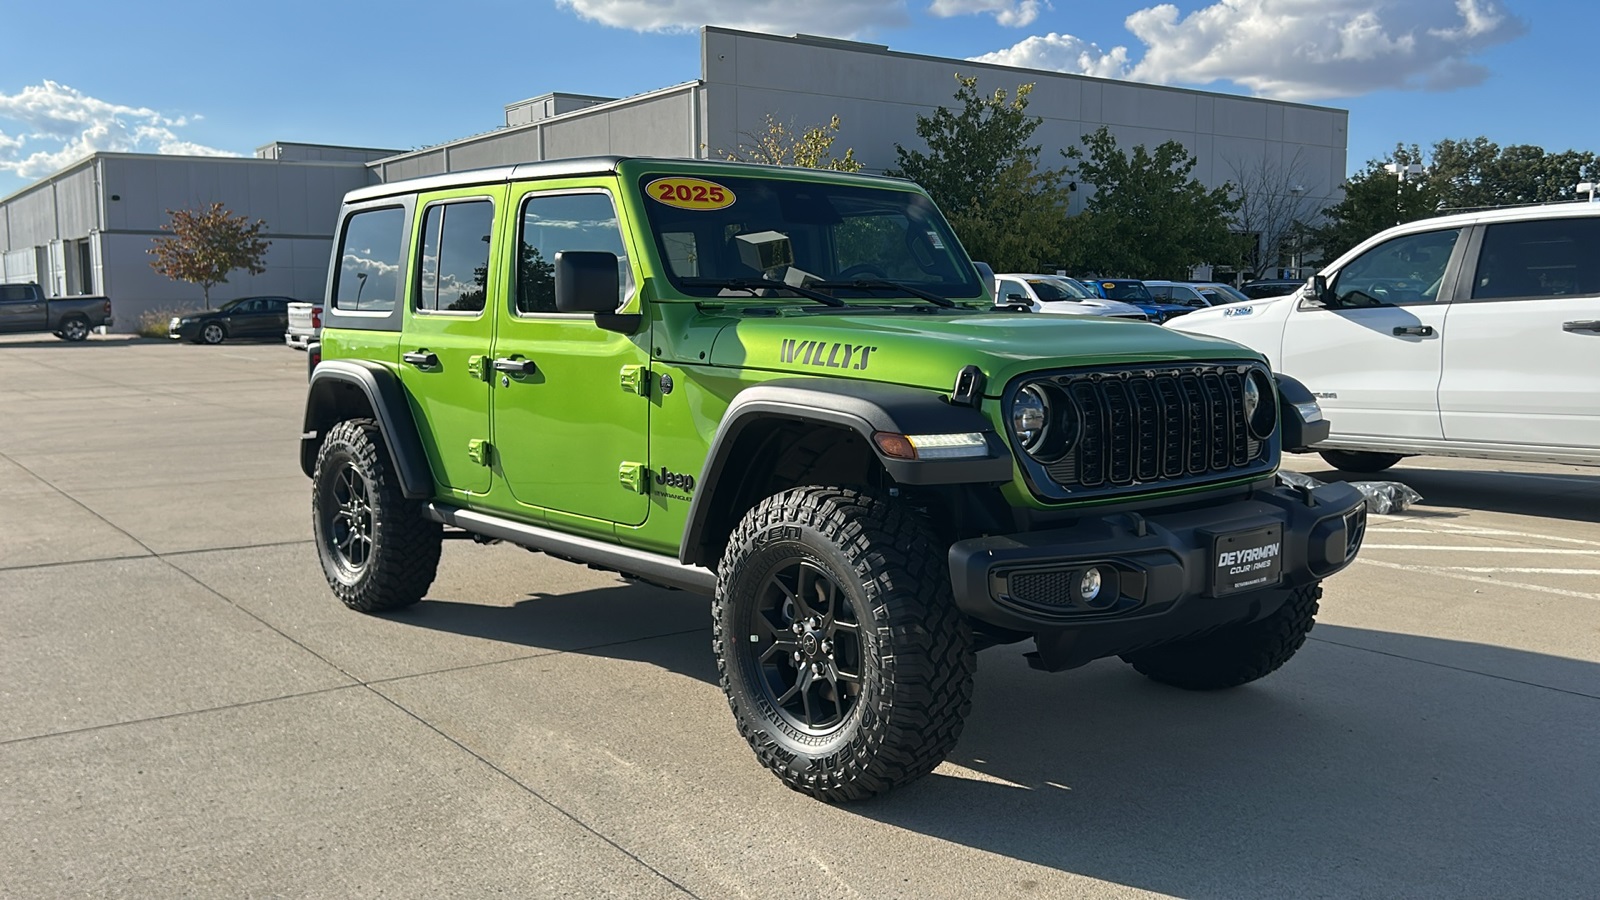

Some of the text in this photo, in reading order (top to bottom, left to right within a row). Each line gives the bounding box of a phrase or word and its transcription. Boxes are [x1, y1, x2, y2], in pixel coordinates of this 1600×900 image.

[658, 183, 725, 203] 2025
[780, 338, 878, 370] WILLYS
[655, 465, 694, 493] Jeep
[1217, 542, 1280, 568] DEYARMAN
[1253, 559, 1272, 571] AMES
